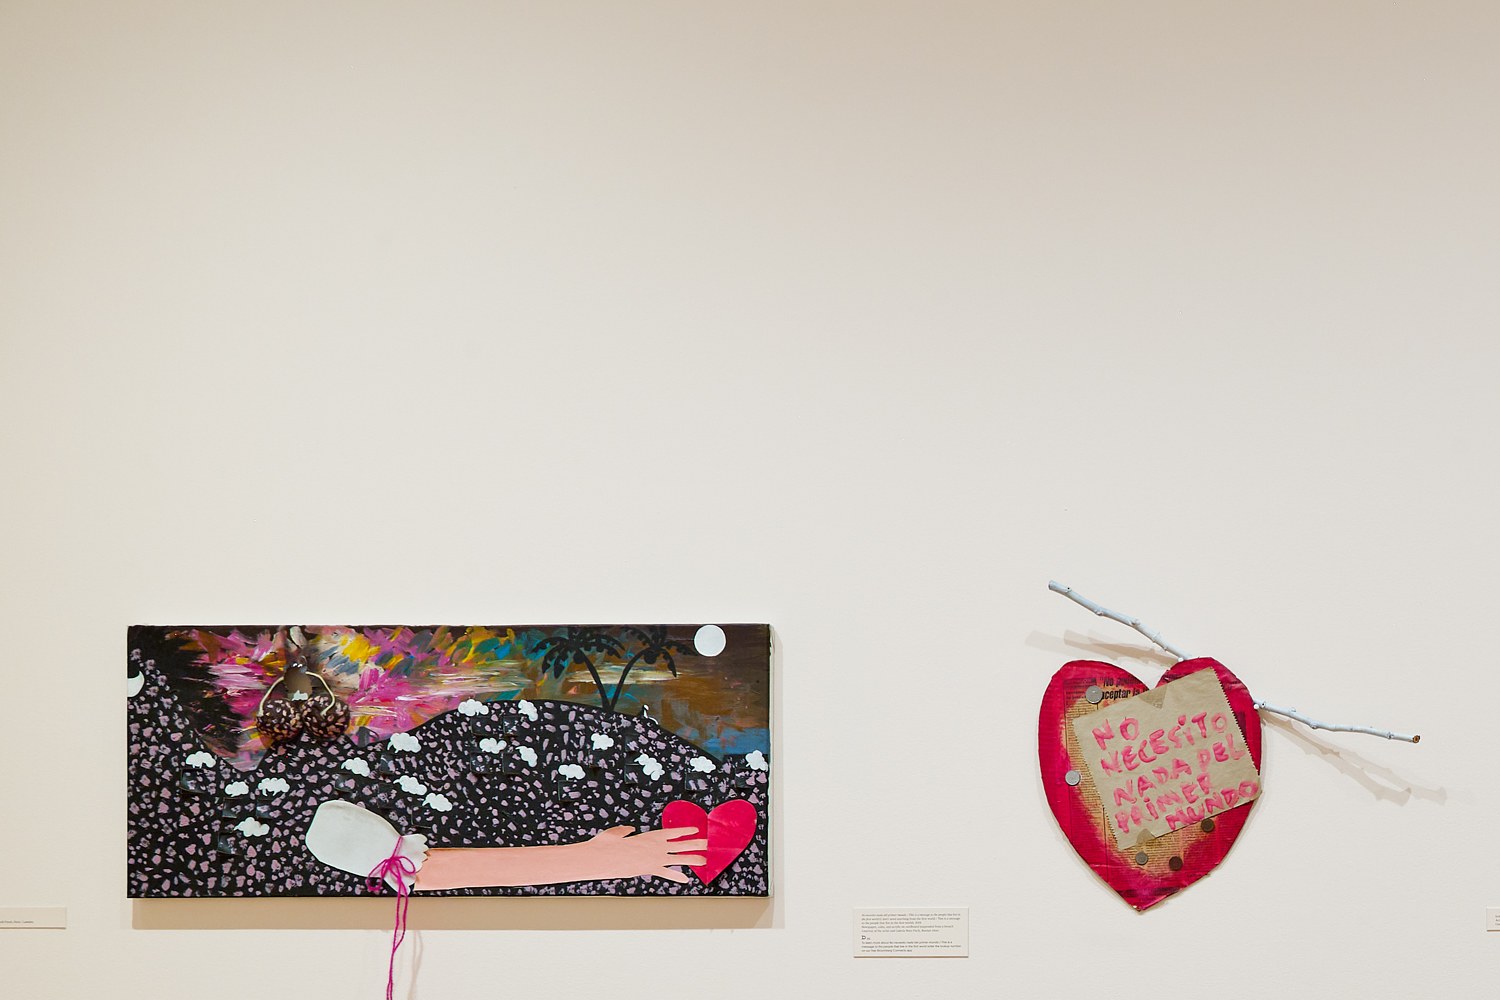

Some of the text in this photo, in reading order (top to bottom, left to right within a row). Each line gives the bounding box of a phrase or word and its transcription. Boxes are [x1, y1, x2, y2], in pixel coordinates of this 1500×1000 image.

[1092, 718, 1140, 750] NO
[1113, 757, 1192, 806] NADA
[1165, 780, 1259, 830] MUNDO
